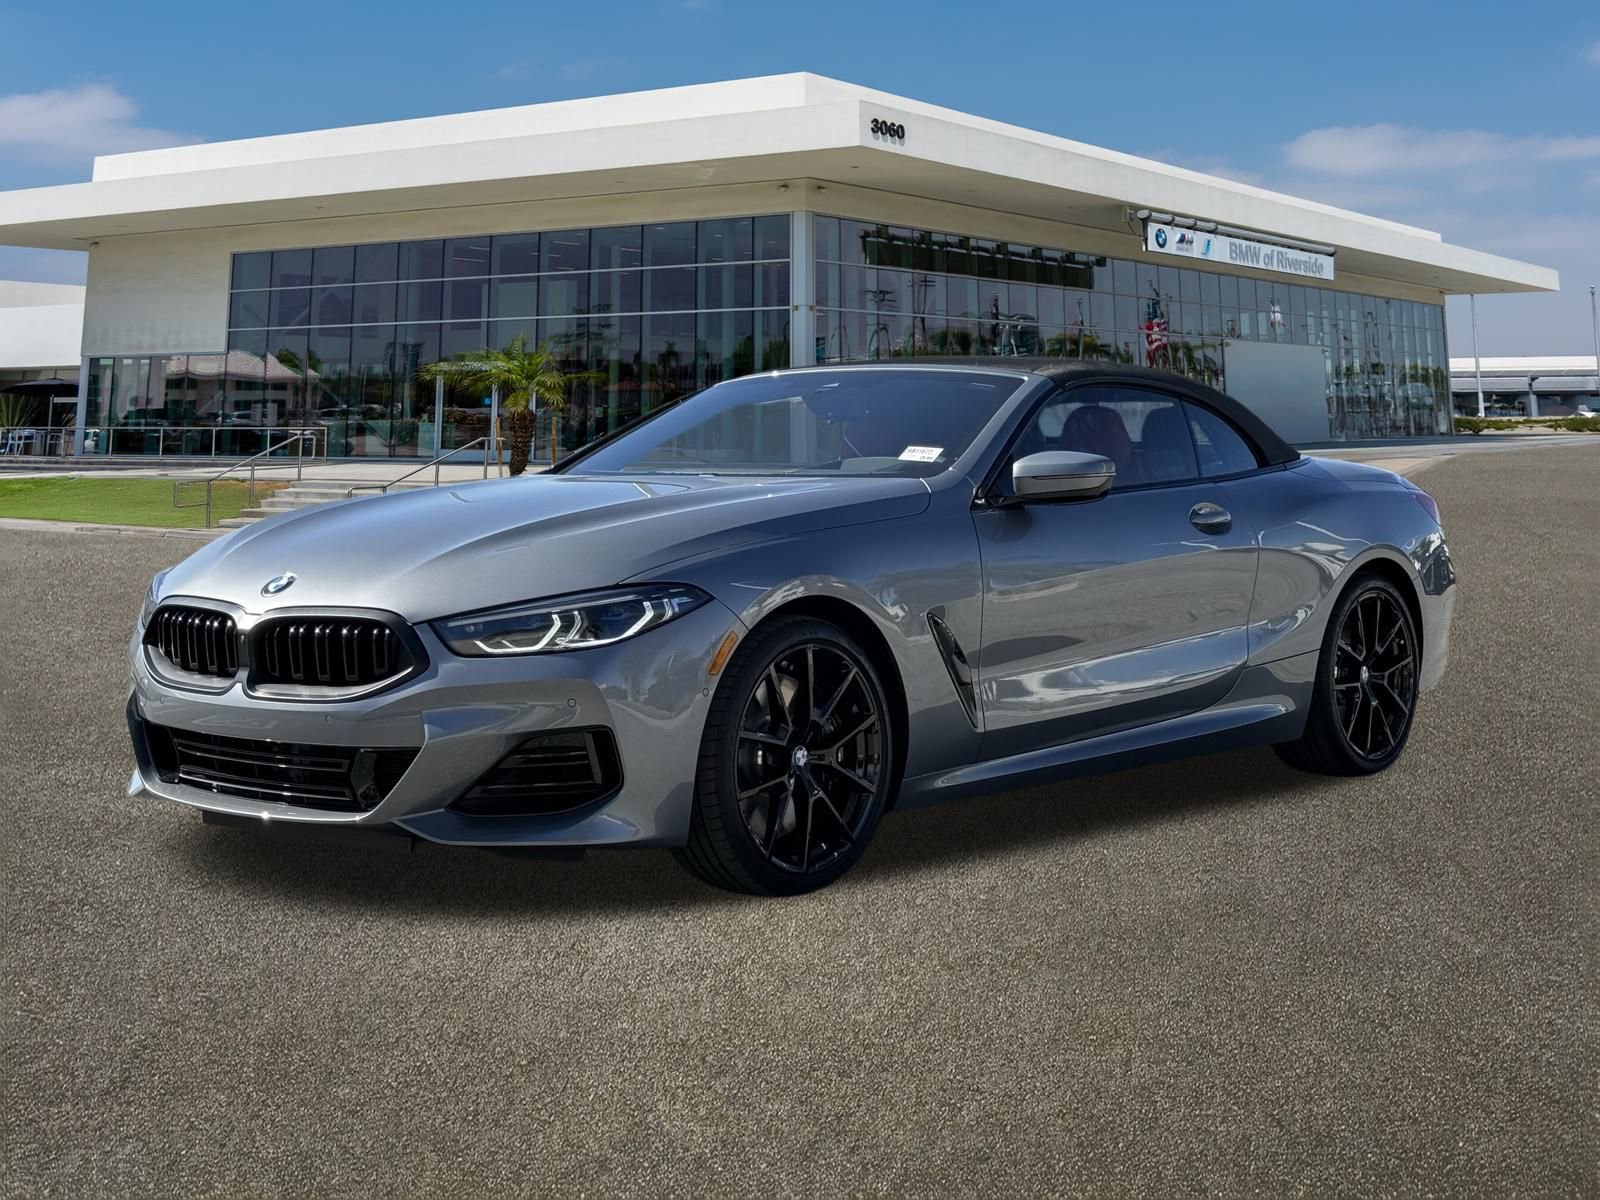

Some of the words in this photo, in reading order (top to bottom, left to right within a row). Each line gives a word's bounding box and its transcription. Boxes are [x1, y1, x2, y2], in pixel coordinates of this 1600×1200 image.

[871, 118, 905, 139] 3060
[1229, 242, 1261, 265] BMW
[1263, 249, 1275, 267] of
[1277, 251, 1324, 275] Riverside
